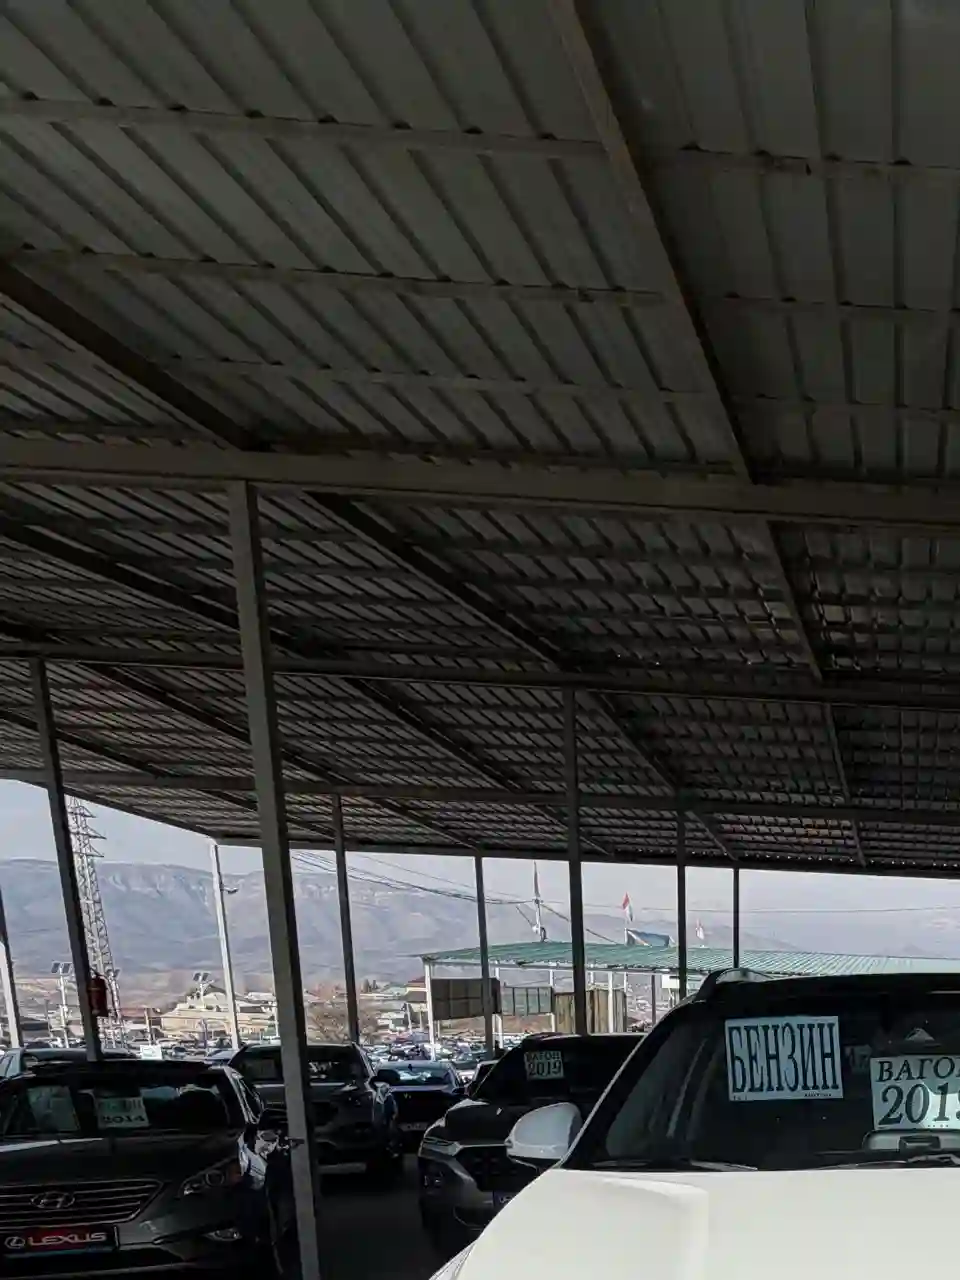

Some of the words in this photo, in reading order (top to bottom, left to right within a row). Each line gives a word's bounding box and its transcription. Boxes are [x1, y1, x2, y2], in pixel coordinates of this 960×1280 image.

[728, 1022, 839, 1092] БЕНЗИН
[528, 1060, 562, 1076] 2019
[27, 1231, 108, 1247] LEXUS
